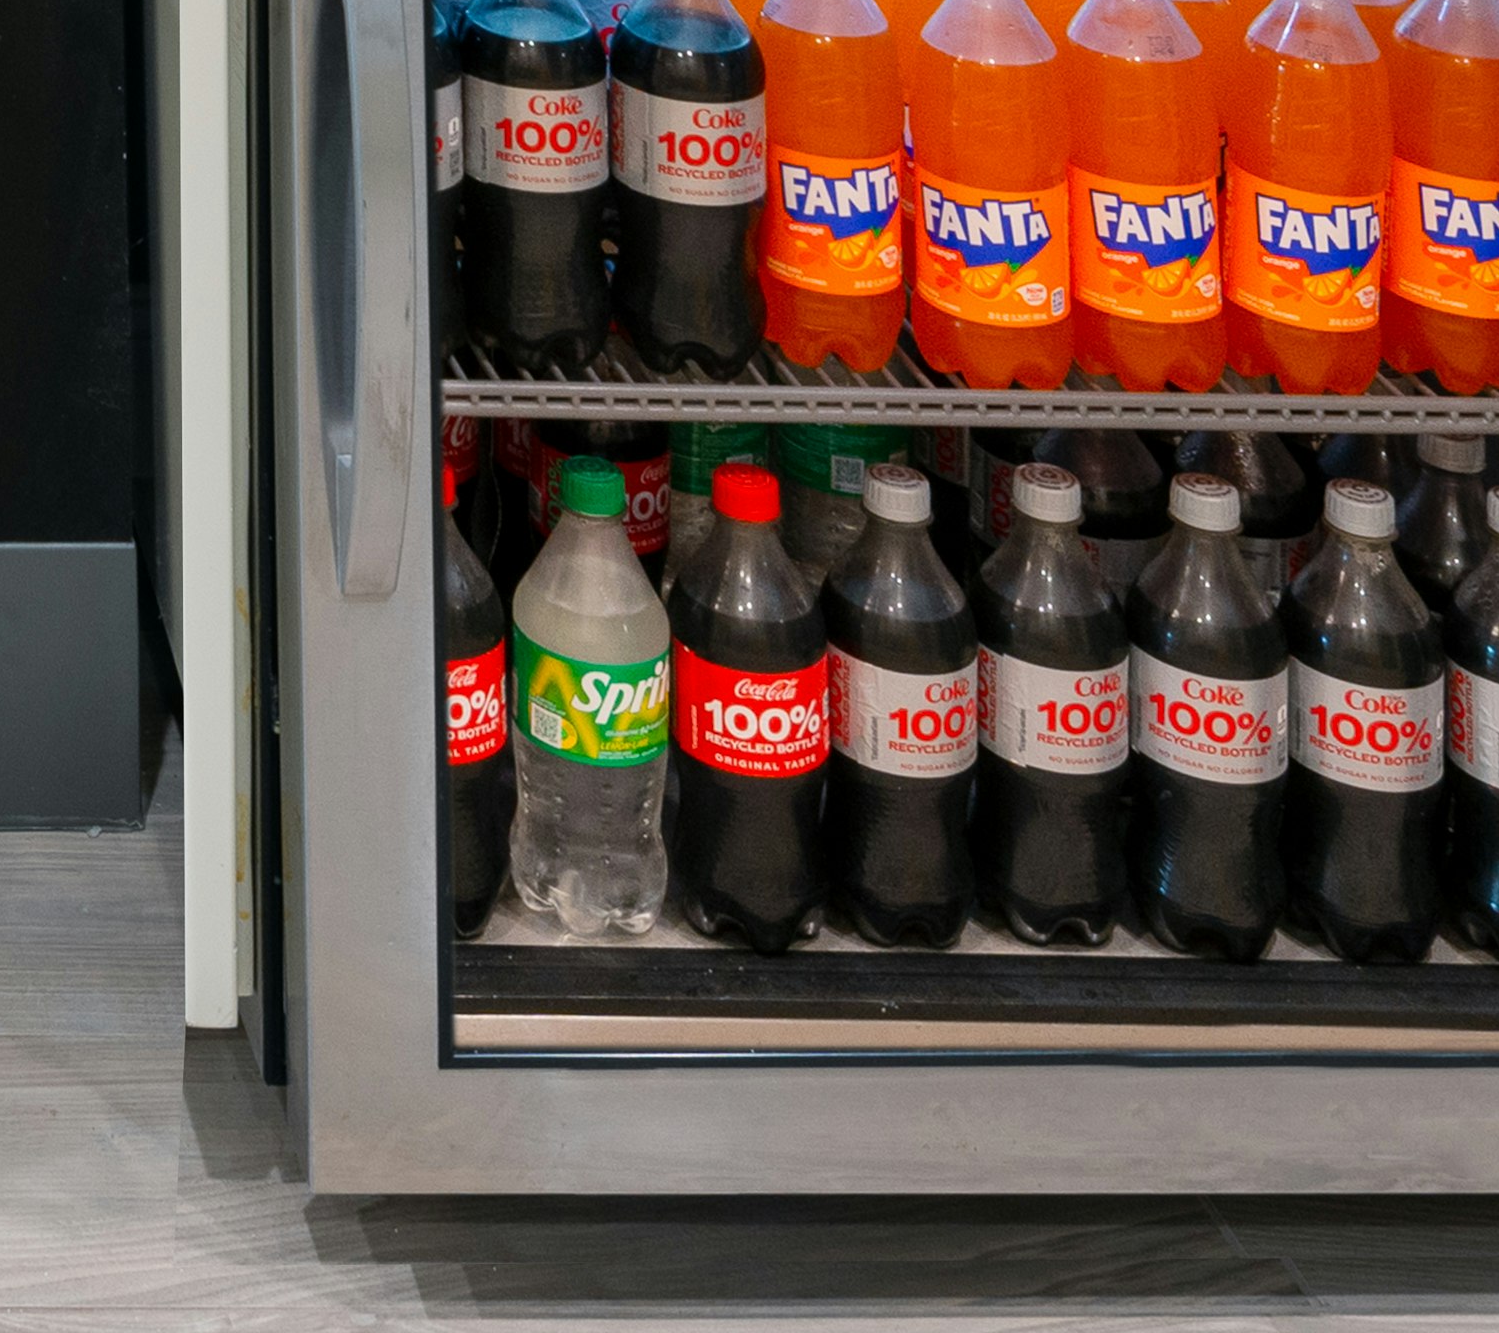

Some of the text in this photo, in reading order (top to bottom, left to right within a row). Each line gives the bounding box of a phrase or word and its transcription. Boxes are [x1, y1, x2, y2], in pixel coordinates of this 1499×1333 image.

[528, 95, 583, 116] Coke
[693, 109, 746, 129] Coke
[495, 118, 603, 153] 100%
[658, 132, 763, 166] 100%
[496, 150, 560, 166] RECYCLED
[658, 164, 724, 179] RECYCLED
[781, 164, 899, 216] FANTA
[922, 187, 1049, 246] FANTA
[1092, 190, 1216, 243] FANTA
[735, 678, 798, 701] Coca-Cola
[705, 699, 820, 741] 100%
[1149, 693, 1271, 744] 100%
[1311, 704, 1432, 753] 100%
[705, 732, 772, 754] RECYCLED
